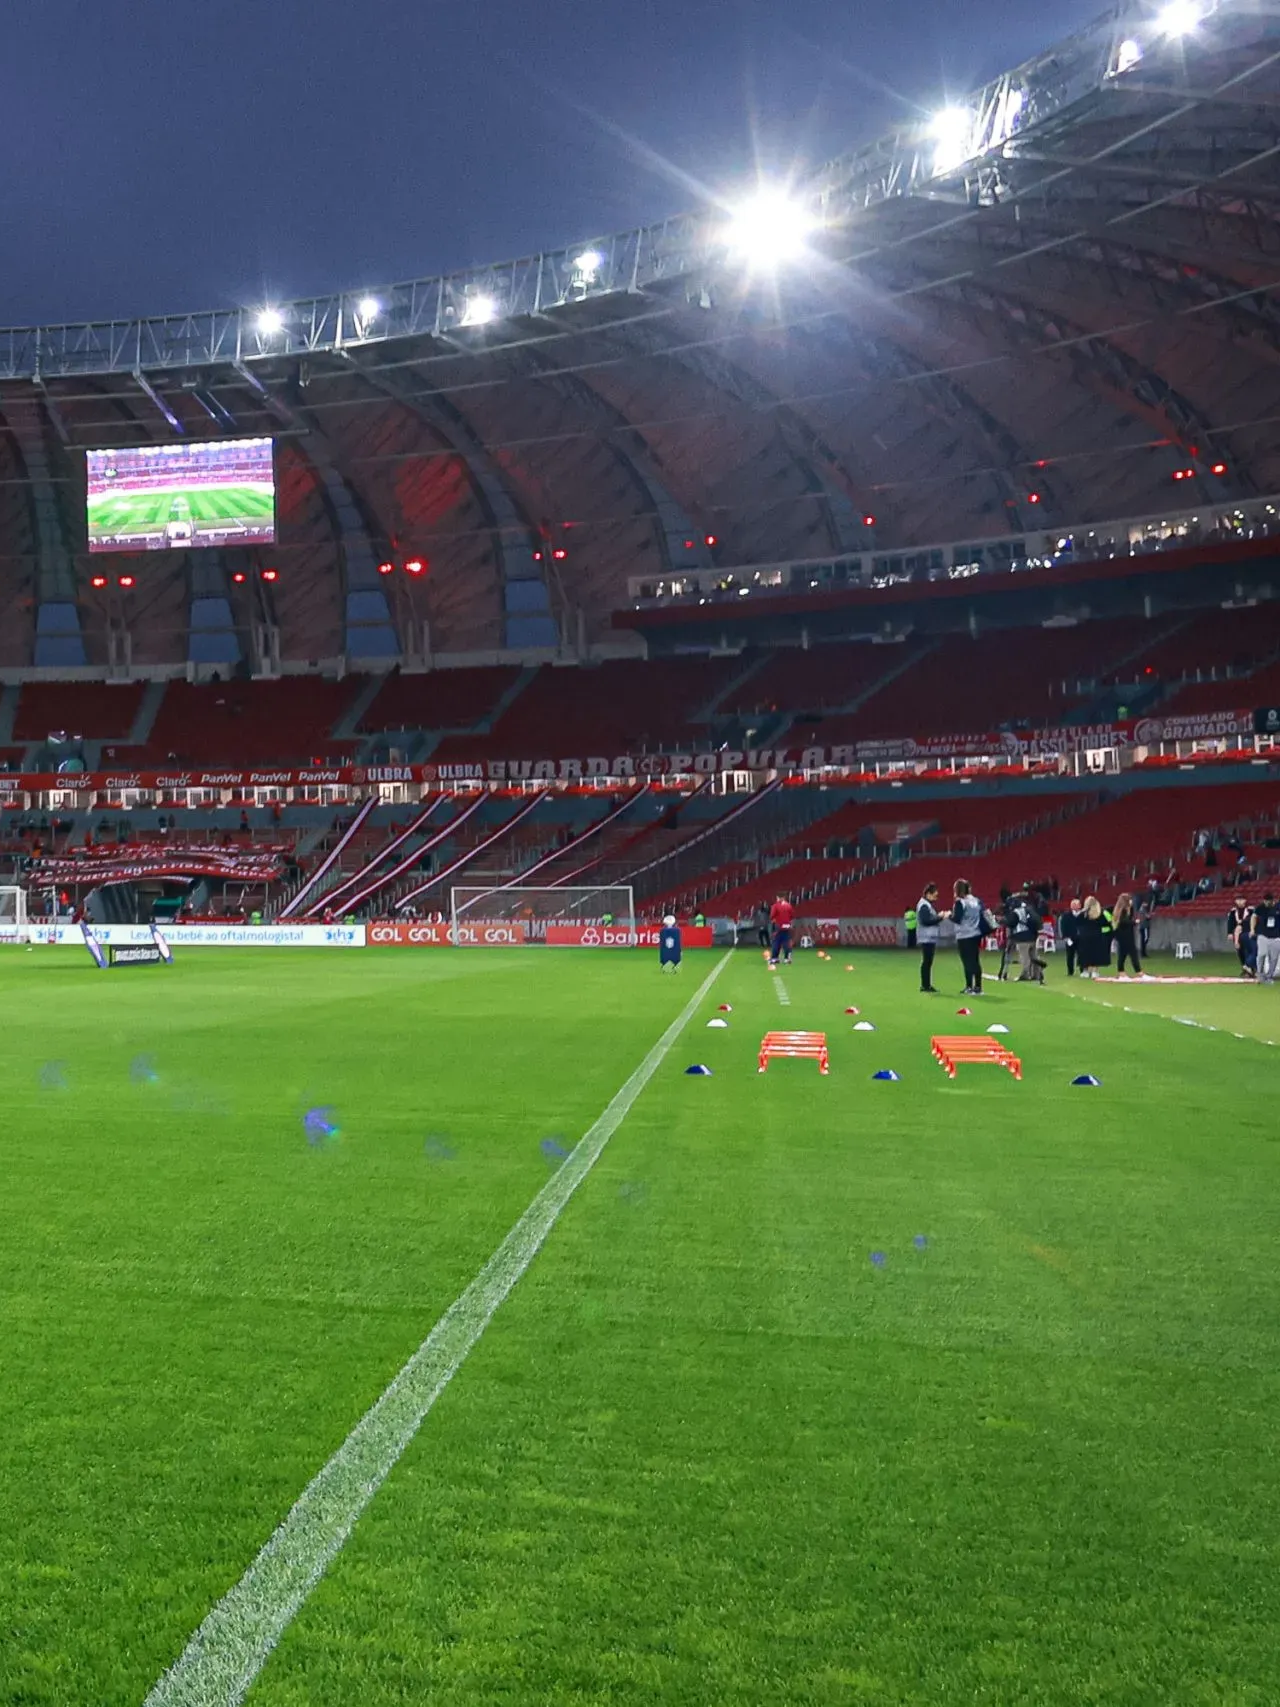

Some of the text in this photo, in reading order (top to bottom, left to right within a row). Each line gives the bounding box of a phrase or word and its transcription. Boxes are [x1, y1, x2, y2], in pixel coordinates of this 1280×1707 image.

[1163, 720, 1238, 740] GRAMADO
[488, 755, 635, 782] GUARDA
[670, 744, 856, 774] POPULAR
[367, 767, 413, 781] ULBRA
[438, 765, 484, 779] ULBRA
[56, 777, 88, 788] Claro
[106, 776, 138, 788] Claro
[156, 776, 188, 787] Claro
[206, 931, 218, 940] ao
[220, 929, 304, 943] oftalmologista!
[371, 928, 402, 942] GOL
[408, 928, 440, 942] GOL
[485, 929, 517, 942] GOL
